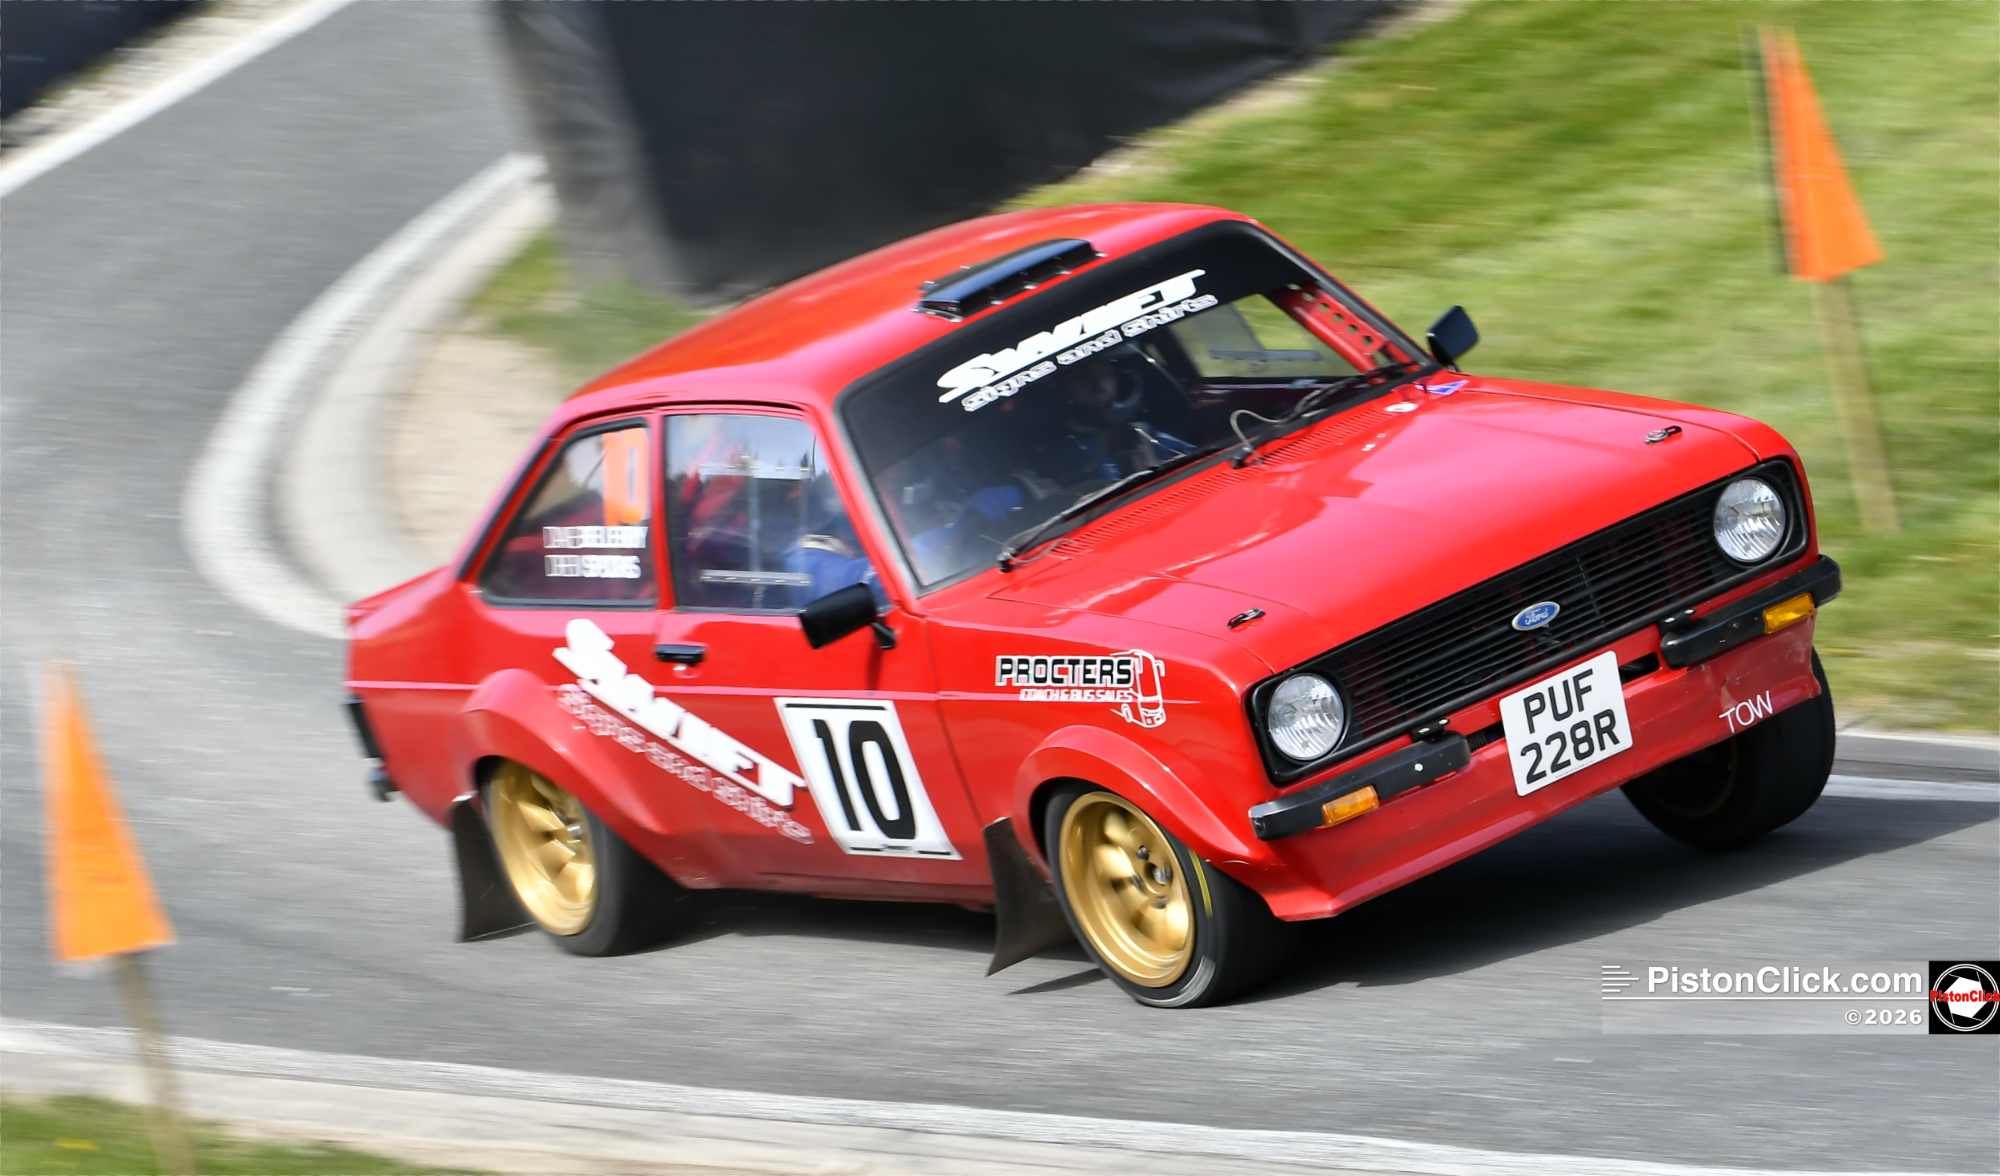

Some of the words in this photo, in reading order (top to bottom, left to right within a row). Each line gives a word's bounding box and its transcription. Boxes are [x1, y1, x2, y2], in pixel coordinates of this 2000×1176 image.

[1524, 607, 1549, 626] Ford
[996, 656, 1134, 687] PROCTERS
[1019, 688, 1059, 701] COACH
[1096, 689, 1133, 703] SALES
[1523, 668, 1594, 734] PUF
[1718, 689, 1773, 734] TOW
[1520, 708, 1621, 785] 228R
[811, 718, 916, 840] 10
